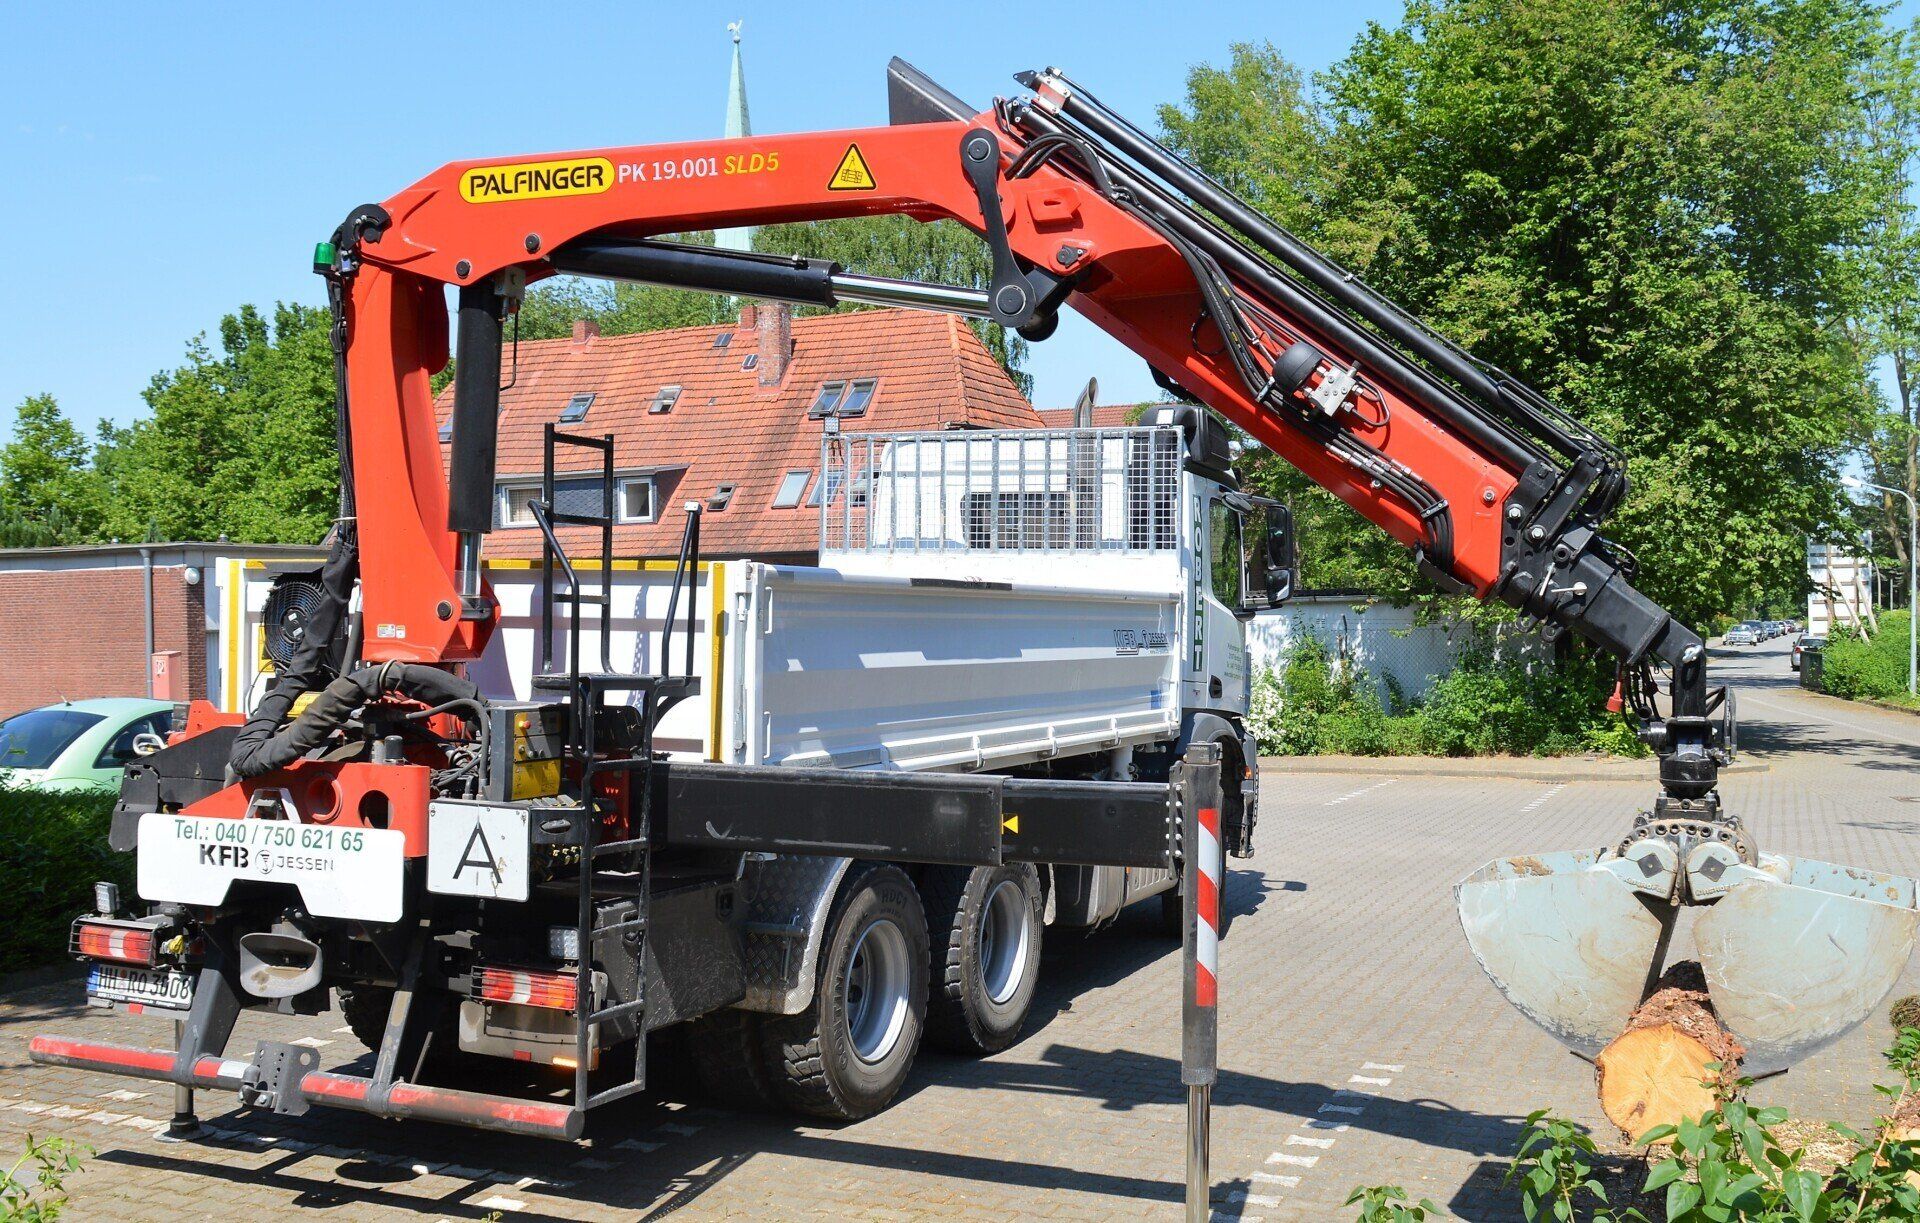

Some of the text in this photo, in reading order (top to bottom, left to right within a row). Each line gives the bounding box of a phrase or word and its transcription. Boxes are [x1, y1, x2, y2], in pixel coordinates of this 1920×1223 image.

[470, 164, 604, 197] PALFINGER
[618, 162, 647, 184] PK
[652, 157, 719, 182] 19.001
[1194, 497, 1203, 670] ROBERT
[174, 818, 364, 852] Tel.: 040 / 750 621 65
[199, 843, 335, 871] KFB JESSEN
[452, 820, 503, 884] A
